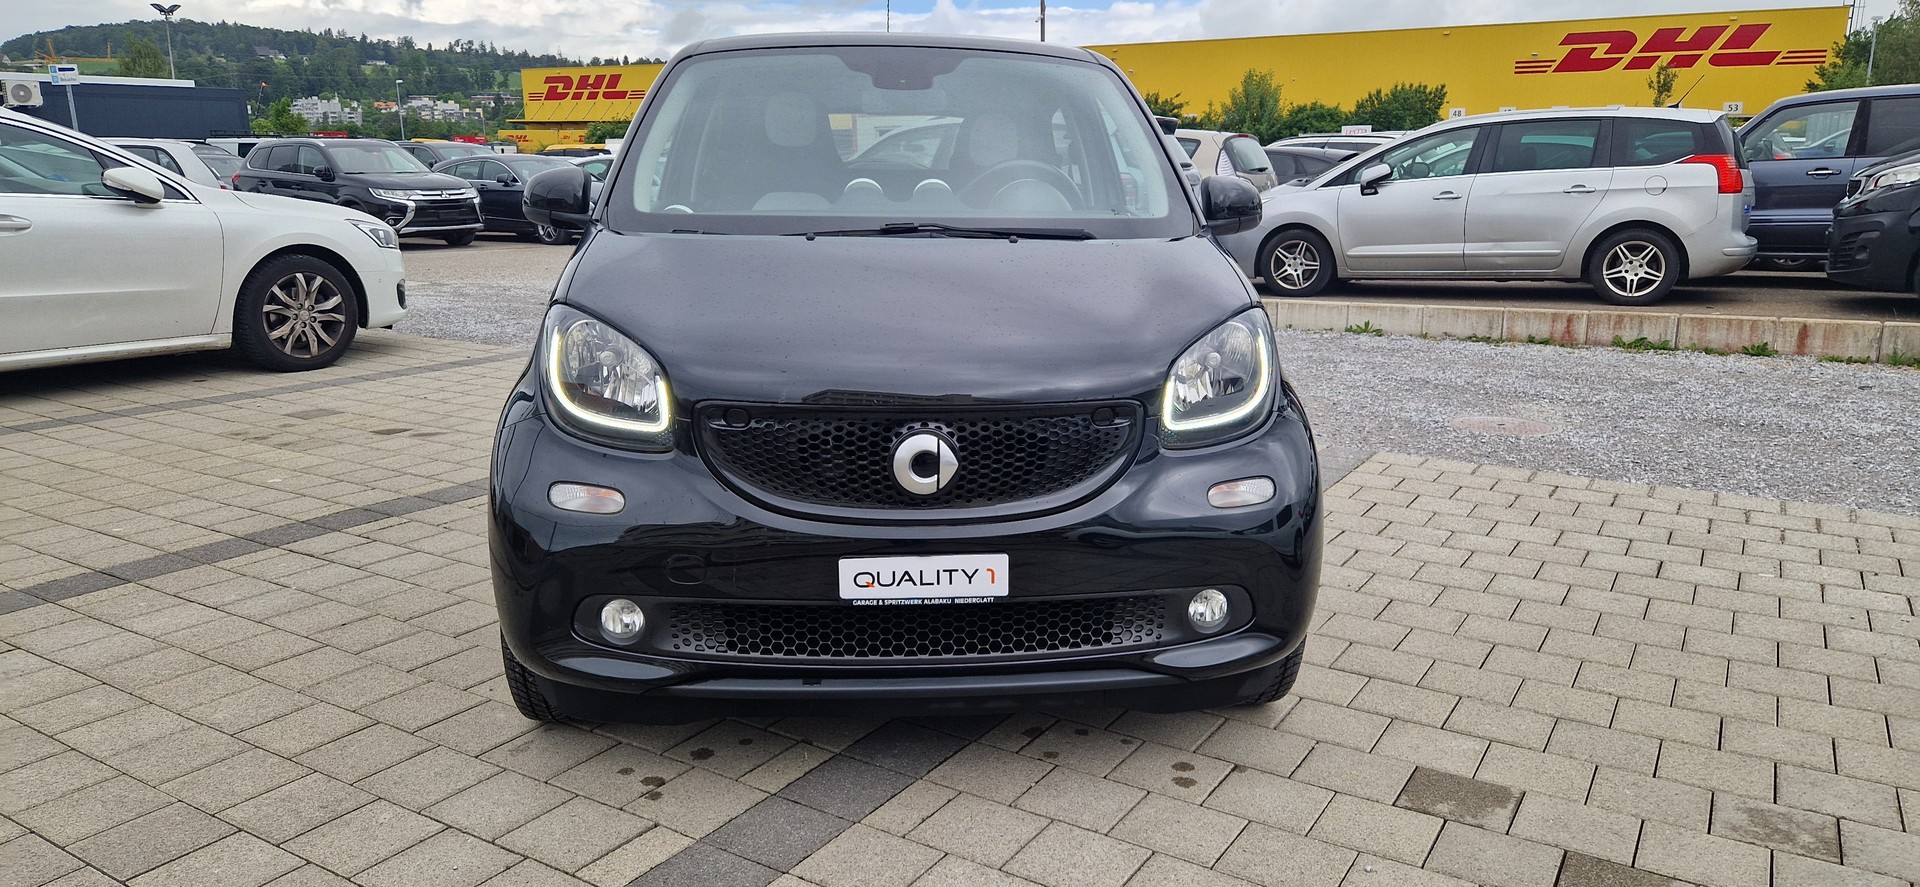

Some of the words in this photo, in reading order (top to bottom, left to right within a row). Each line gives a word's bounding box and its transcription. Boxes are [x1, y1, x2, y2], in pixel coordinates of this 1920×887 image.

[1551, 23, 1783, 73] DHL
[543, 74, 629, 101] DHL
[1728, 104, 1739, 112] 53
[853, 568, 980, 588] QUALITY
[986, 568, 995, 584] 1
[884, 598, 923, 606] SPRITZWERK
